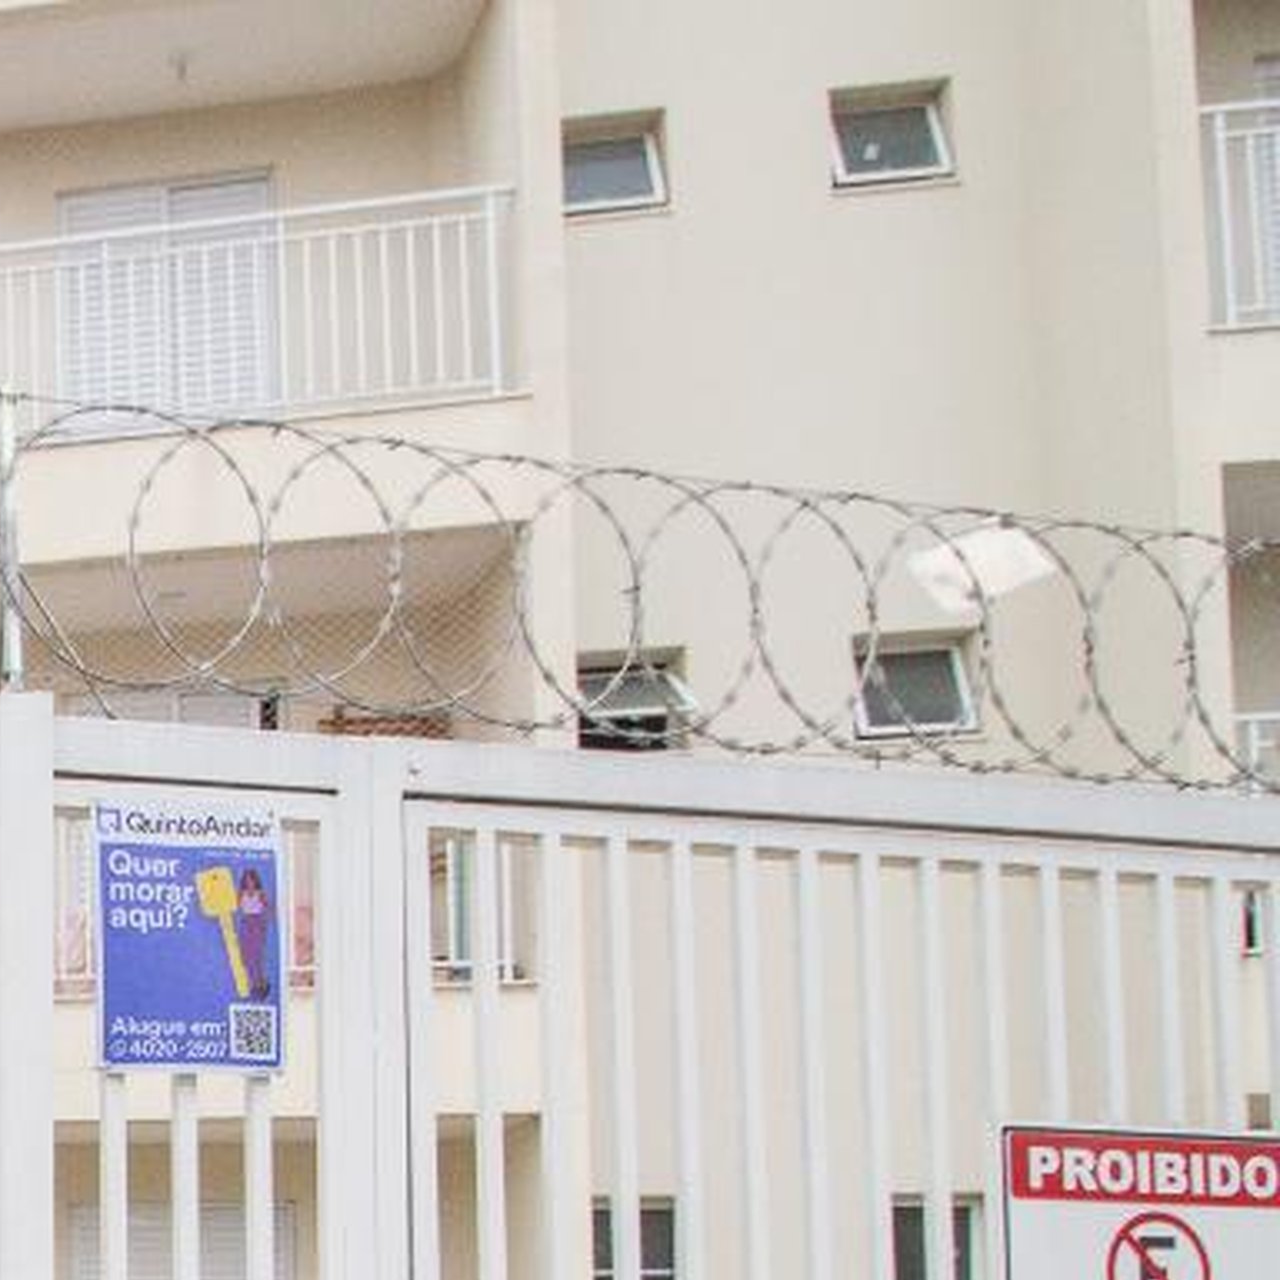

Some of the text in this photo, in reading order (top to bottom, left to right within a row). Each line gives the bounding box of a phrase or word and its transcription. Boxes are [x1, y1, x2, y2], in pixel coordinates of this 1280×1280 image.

[125, 810, 269, 838] QuintoAndar
[108, 849, 180, 877] Quer
[109, 883, 193, 902] morar
[109, 904, 188, 934] aqui?
[1028, 1146, 1279, 1199] PROIBIDO
